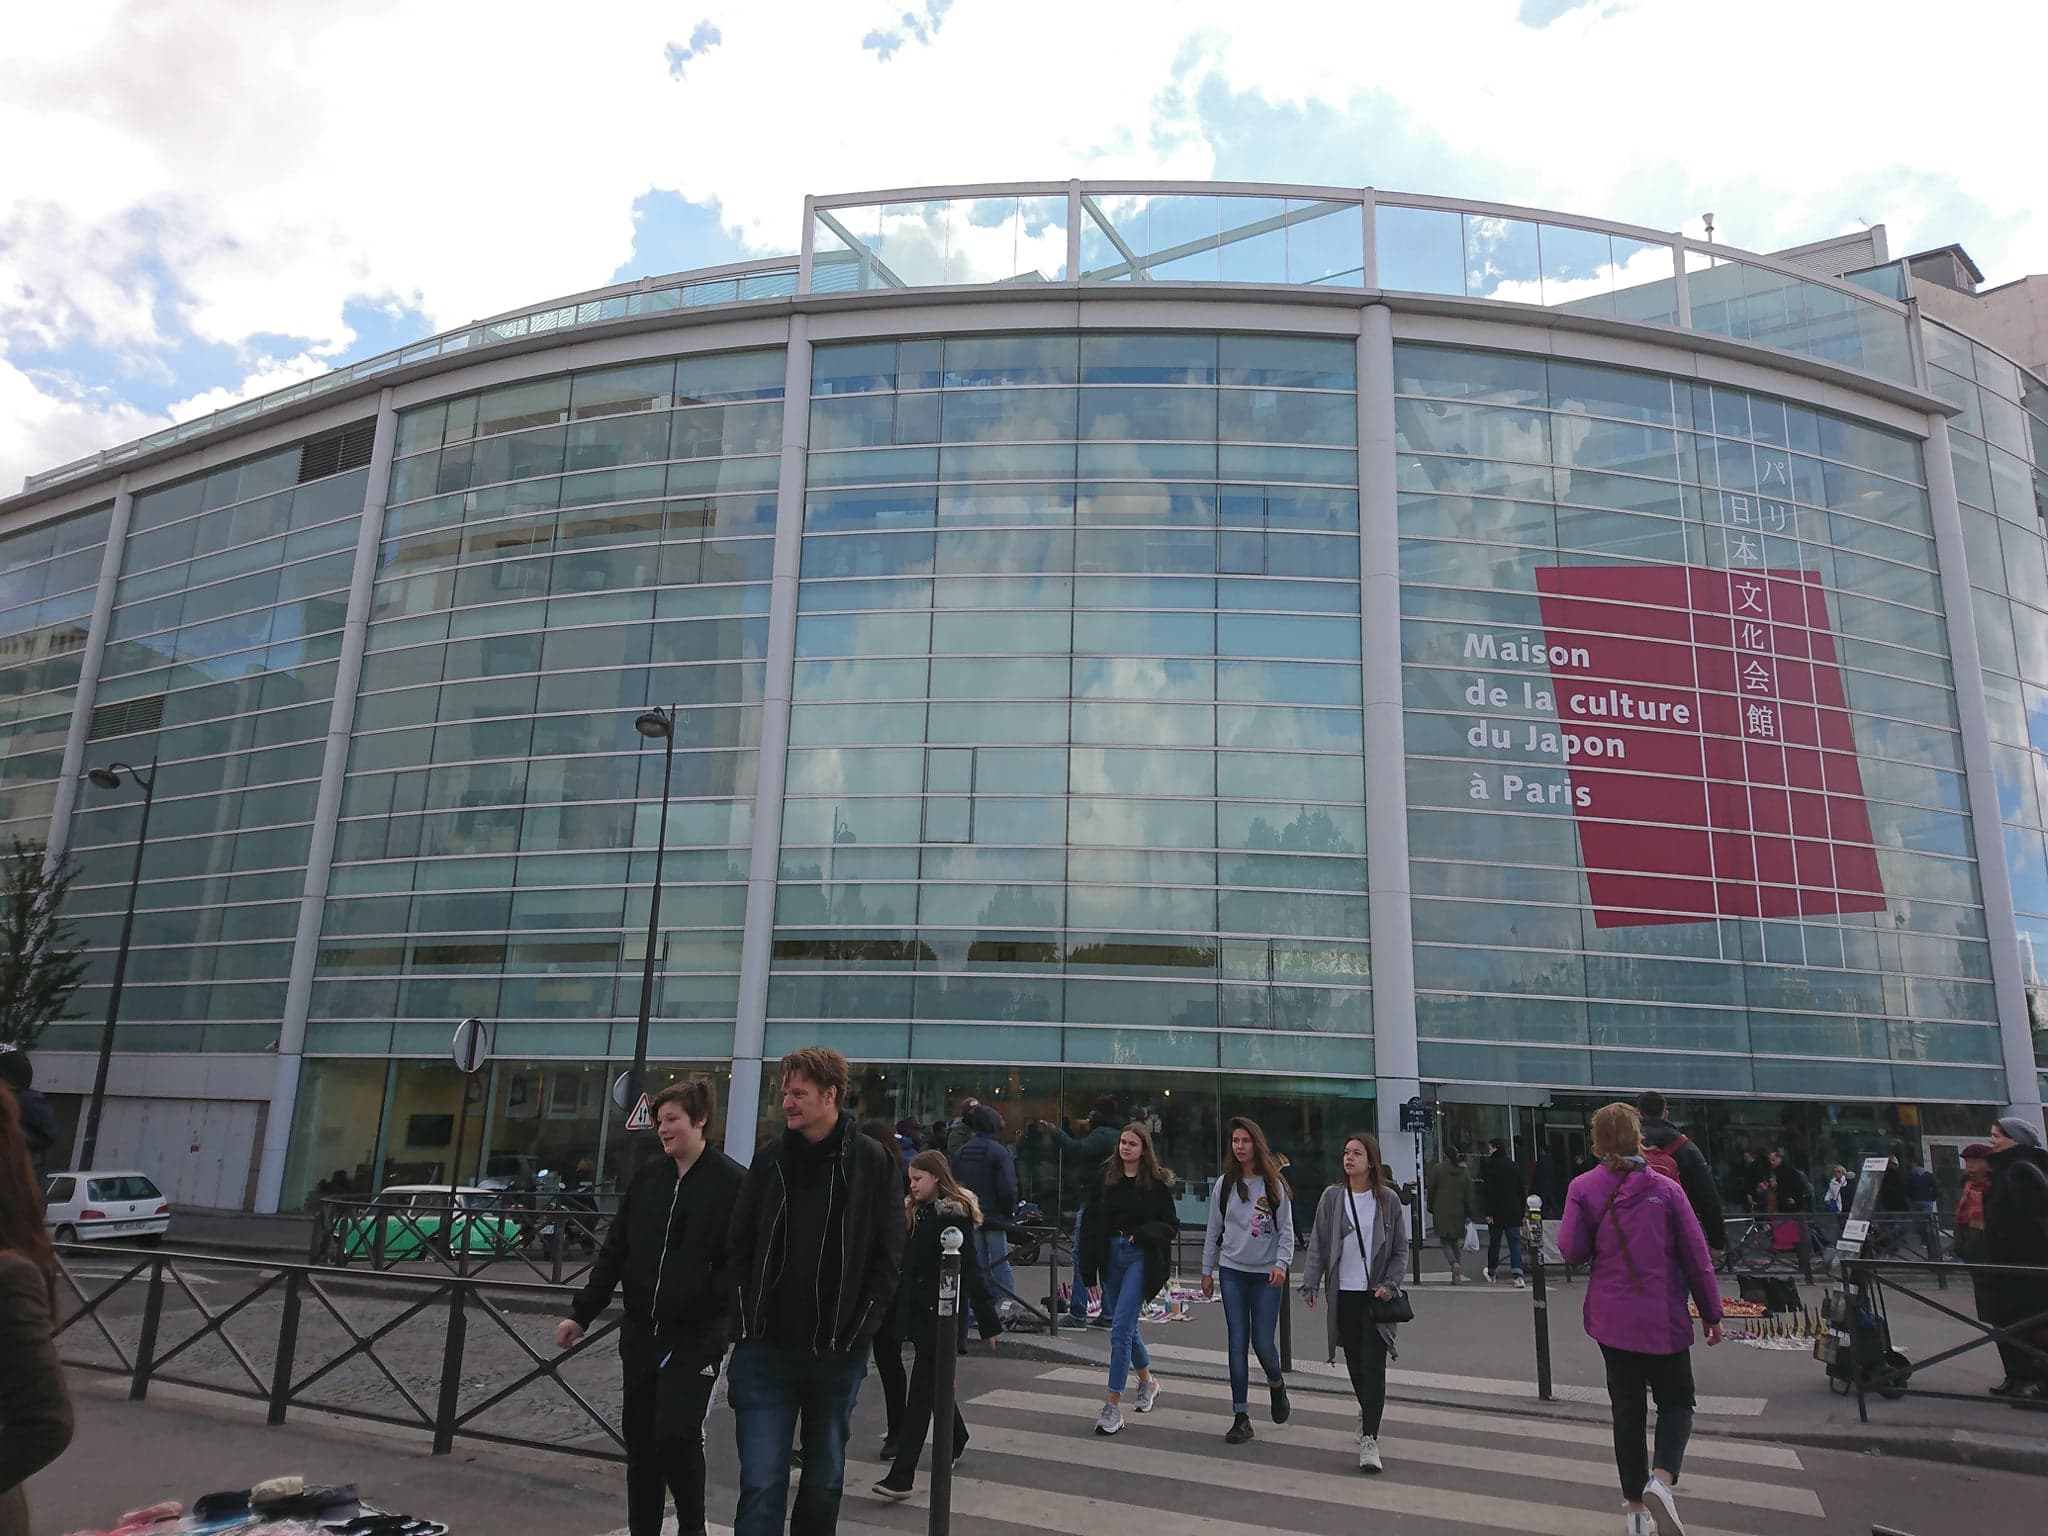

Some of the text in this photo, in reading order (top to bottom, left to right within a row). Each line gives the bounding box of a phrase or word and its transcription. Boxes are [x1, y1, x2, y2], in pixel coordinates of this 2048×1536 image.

[1761, 460, 1786, 532] パリ
[1730, 495, 1775, 737] 日本文化会館
[1463, 632, 1591, 668] Maison
[1465, 678, 1691, 724] de la culture
[1467, 719, 1626, 762] du Japon
[1469, 772, 1592, 807] à Paris
